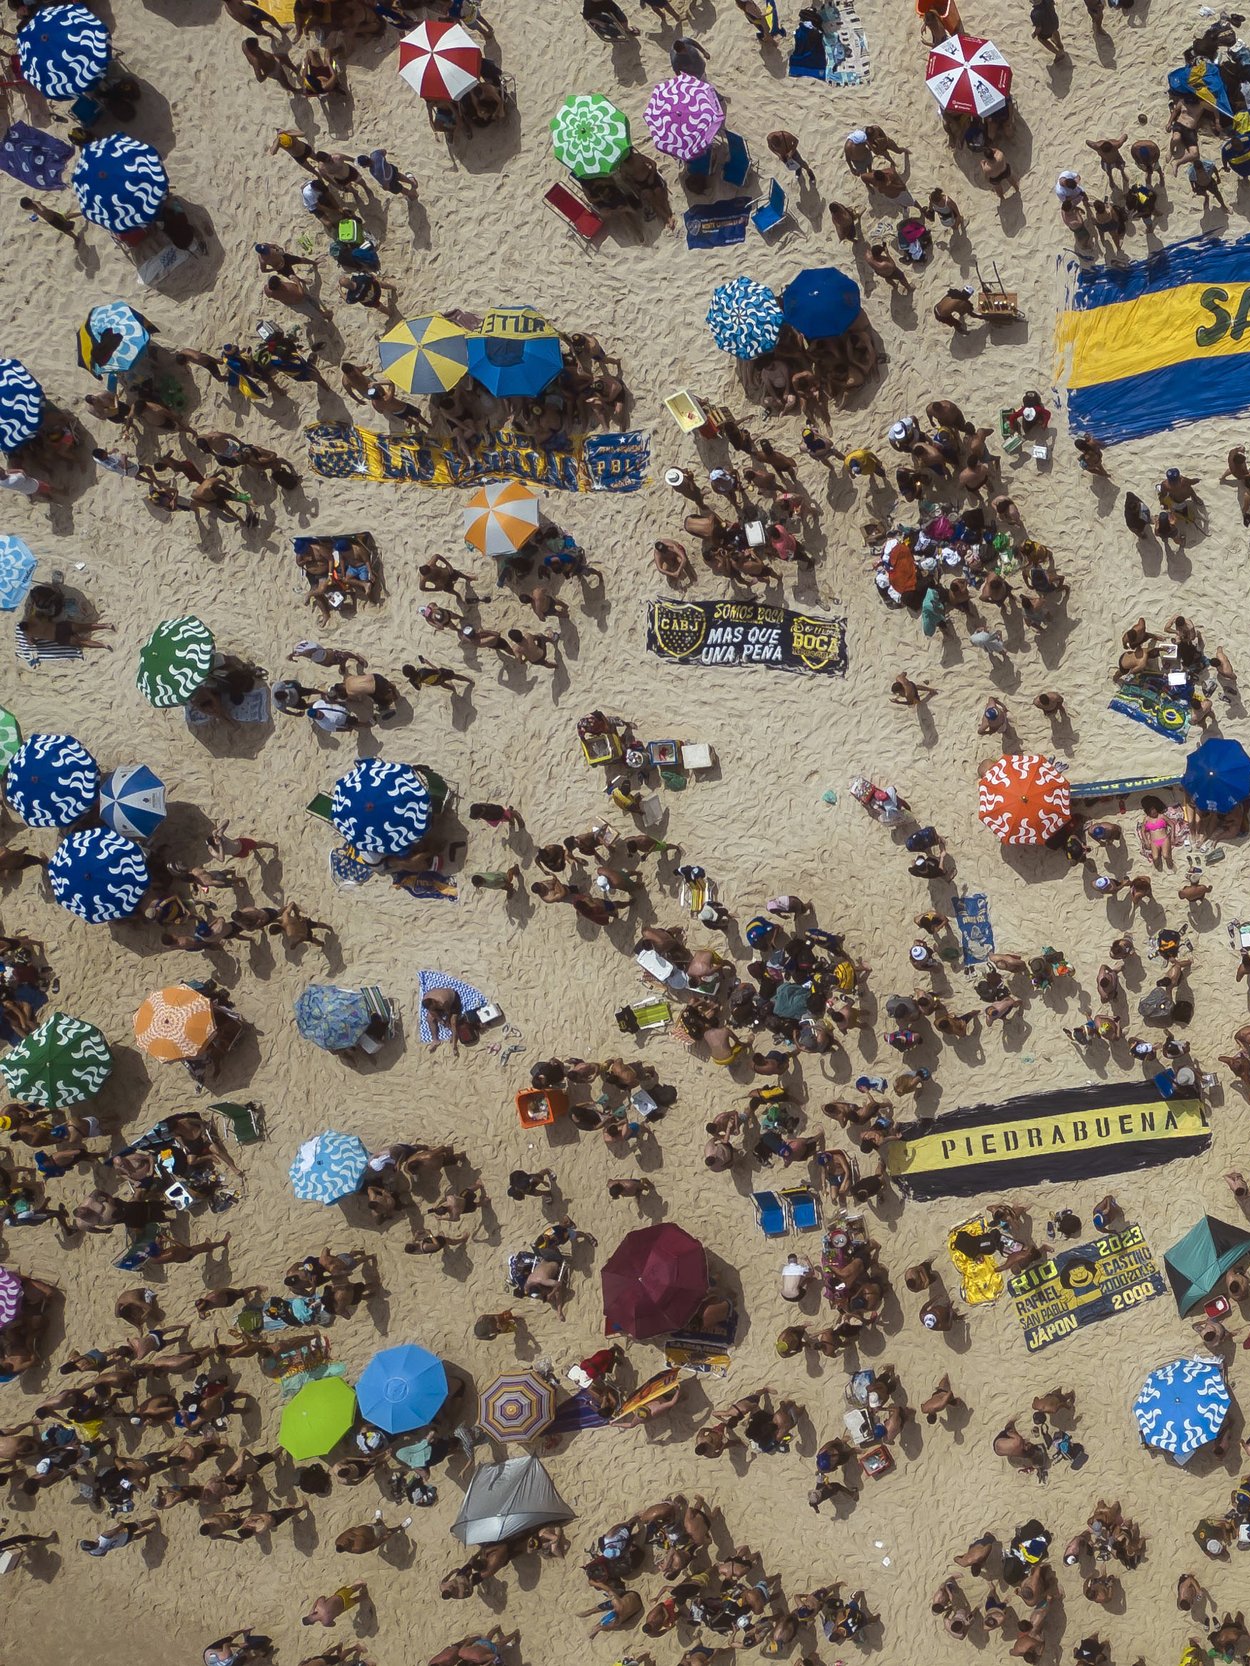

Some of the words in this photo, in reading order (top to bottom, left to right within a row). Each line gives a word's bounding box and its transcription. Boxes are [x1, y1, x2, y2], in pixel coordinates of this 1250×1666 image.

[661, 618, 698, 631] CABJ
[714, 603, 753, 620] SOMOS
[757, 607, 785, 623] BOCA
[707, 627, 744, 645] MAS
[748, 627, 782, 645] QUE
[792, 633, 839, 653] BOCA
[702, 646, 737, 665] UNA
[743, 642, 783, 661] PEÑA
[941, 1111, 1179, 1160] PIEDRABUENA
[1011, 1260, 1058, 1296] RIO
[1098, 1225, 1144, 1257] 2023
[1015, 1284, 1061, 1316] RAFAEL
[1111, 1281, 1154, 1311] 2000
[1019, 1312, 1042, 1330] SAN
[1042, 1300, 1069, 1322] PABLO
